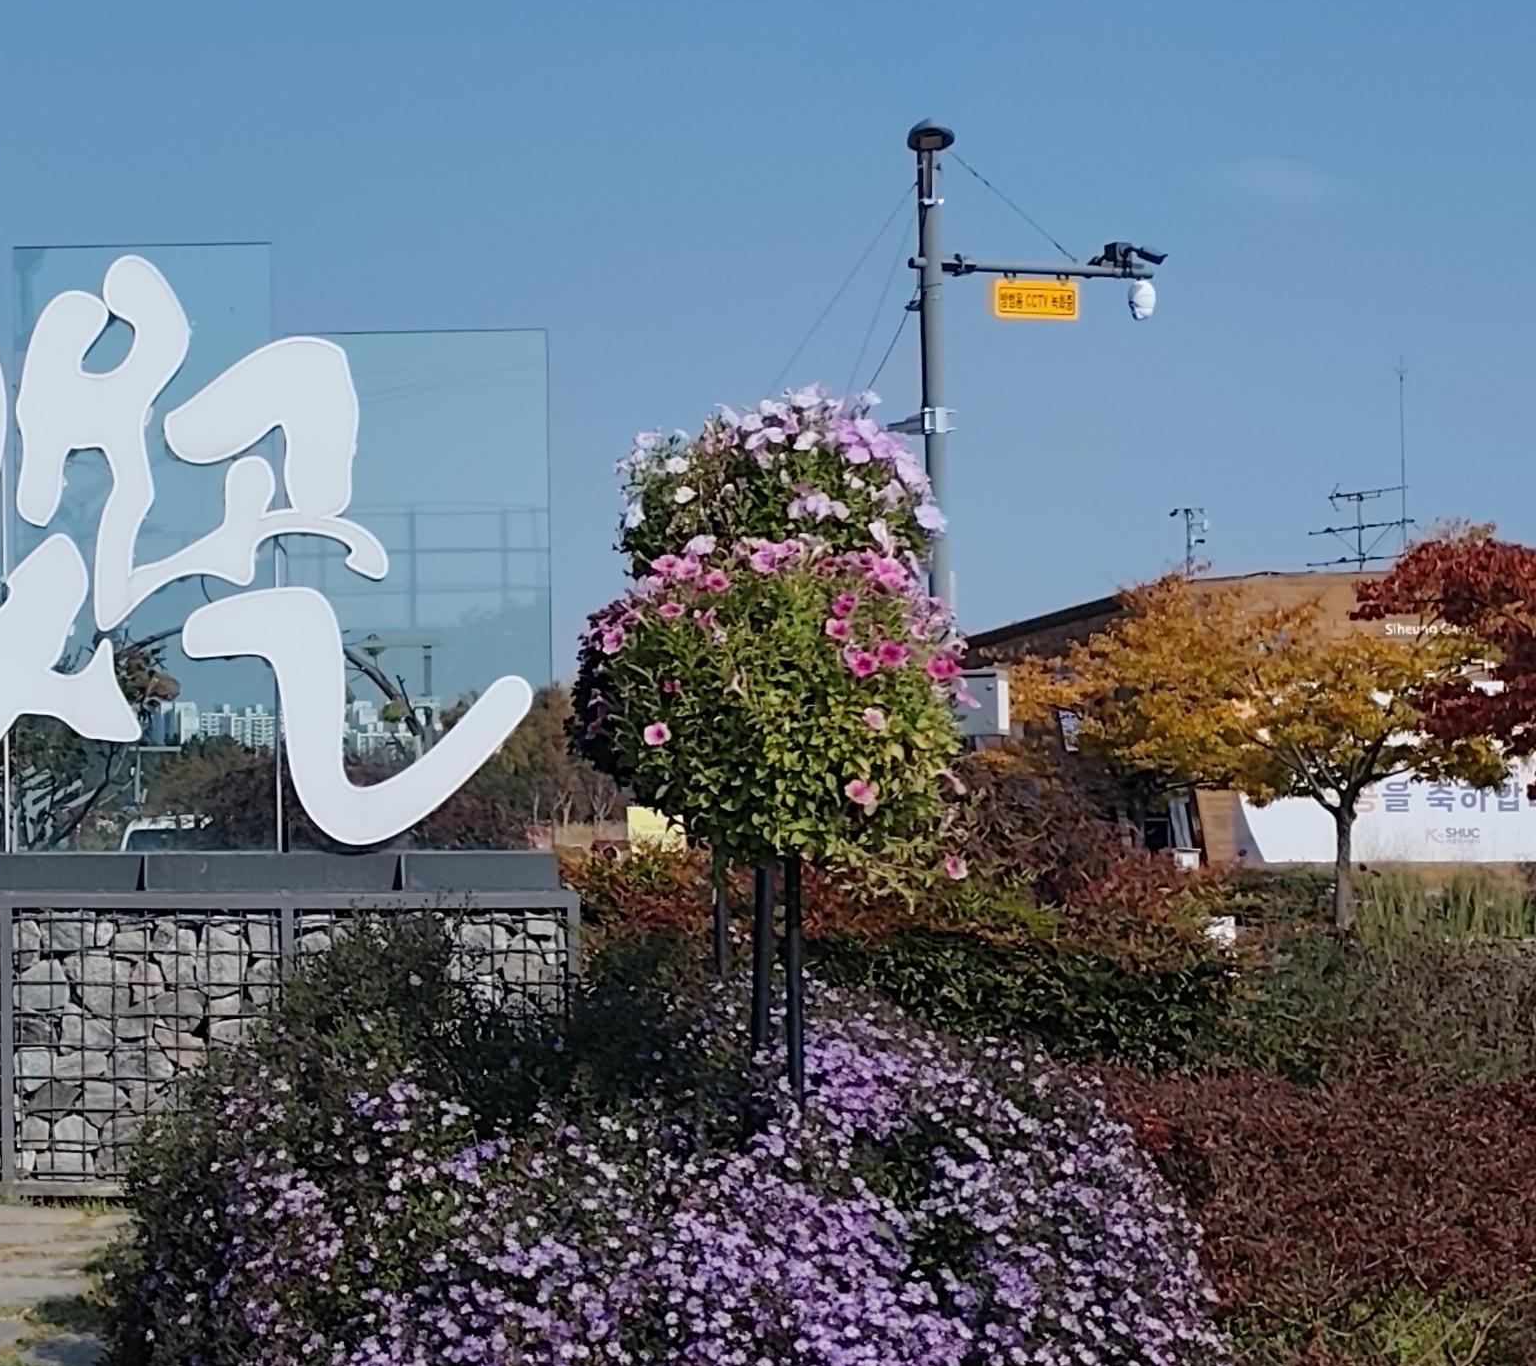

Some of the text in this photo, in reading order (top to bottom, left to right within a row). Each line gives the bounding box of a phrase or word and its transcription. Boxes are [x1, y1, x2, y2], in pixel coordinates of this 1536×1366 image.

[1000, 292, 1073, 311] 방범용 CCTV 녹화중
[1426, 779, 1536, 813] 축하합
[1445, 827, 1481, 839] SHUC
